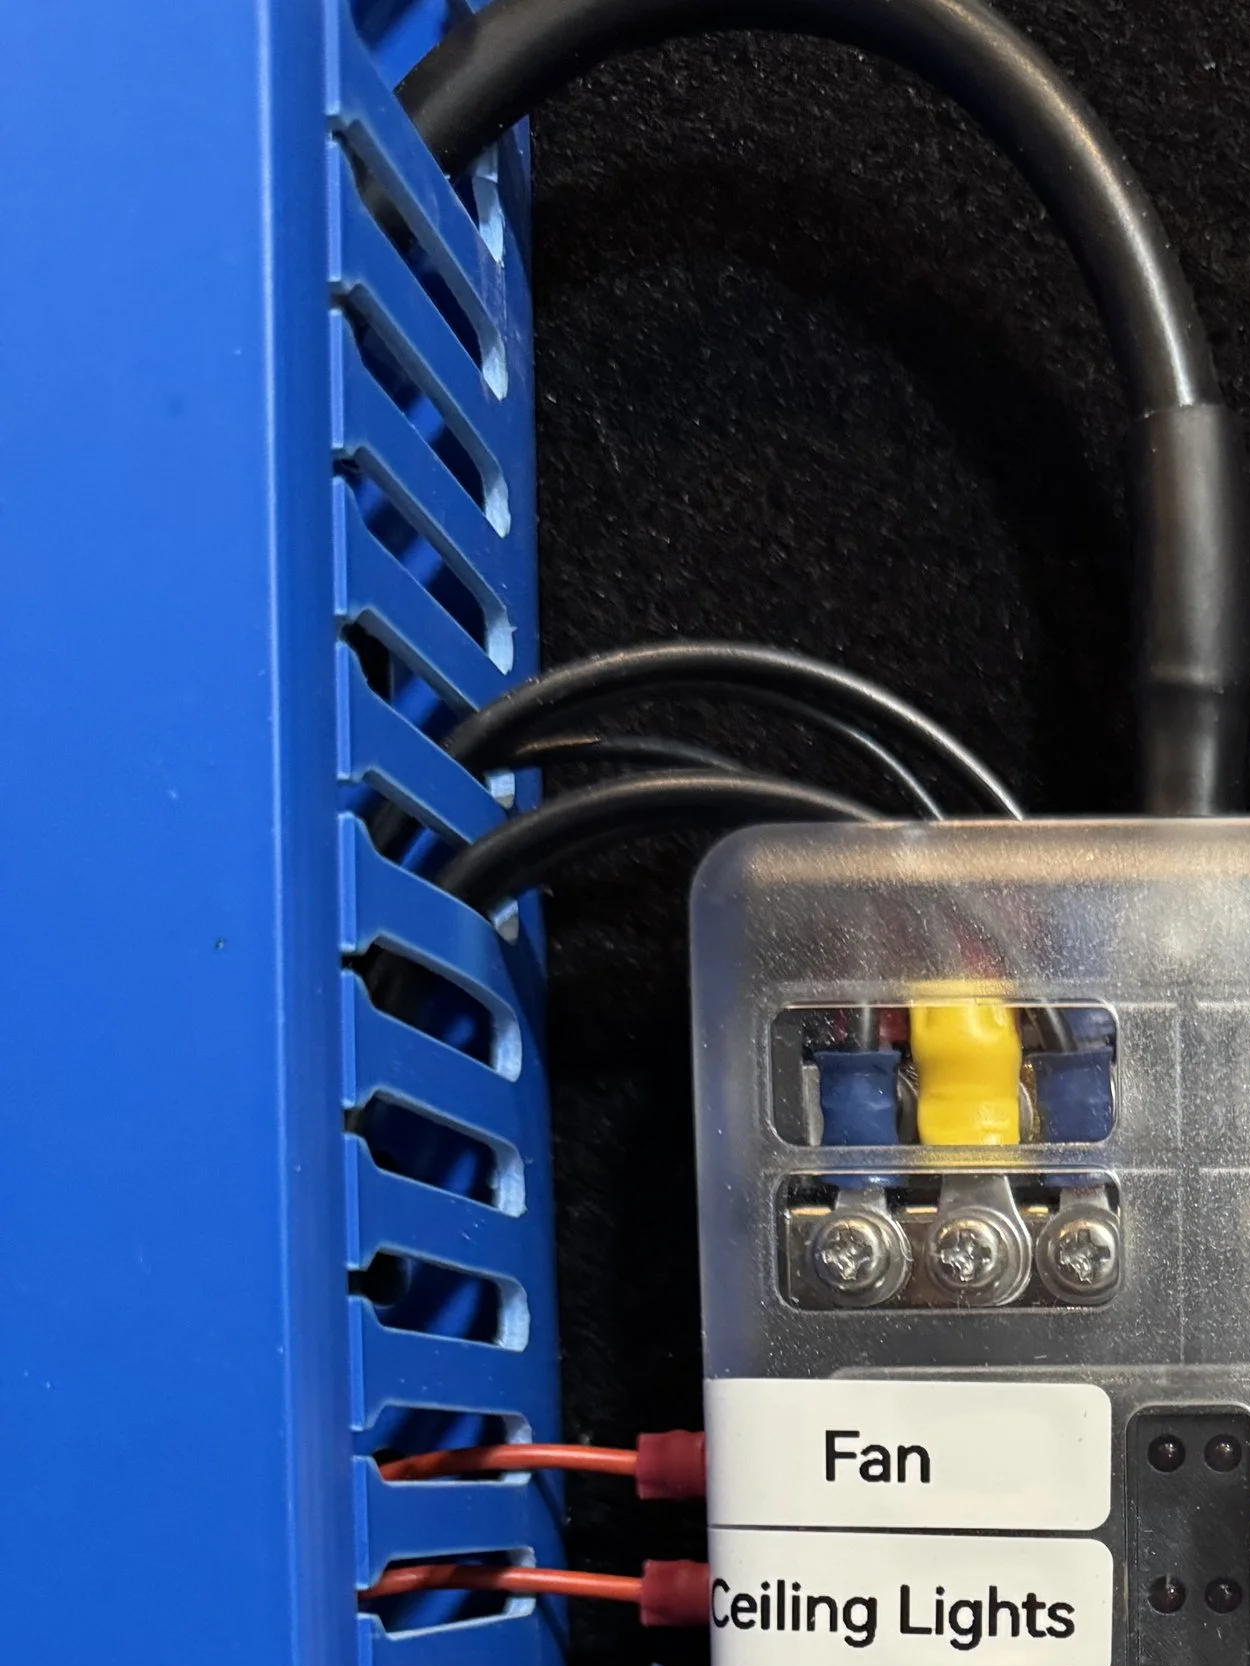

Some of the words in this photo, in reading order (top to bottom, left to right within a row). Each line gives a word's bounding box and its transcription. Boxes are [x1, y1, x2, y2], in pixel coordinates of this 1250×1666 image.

[825, 1429, 931, 1484] Fan
[710, 1577, 878, 1648] Ceiling
[899, 1584, 1075, 1651] Lights
